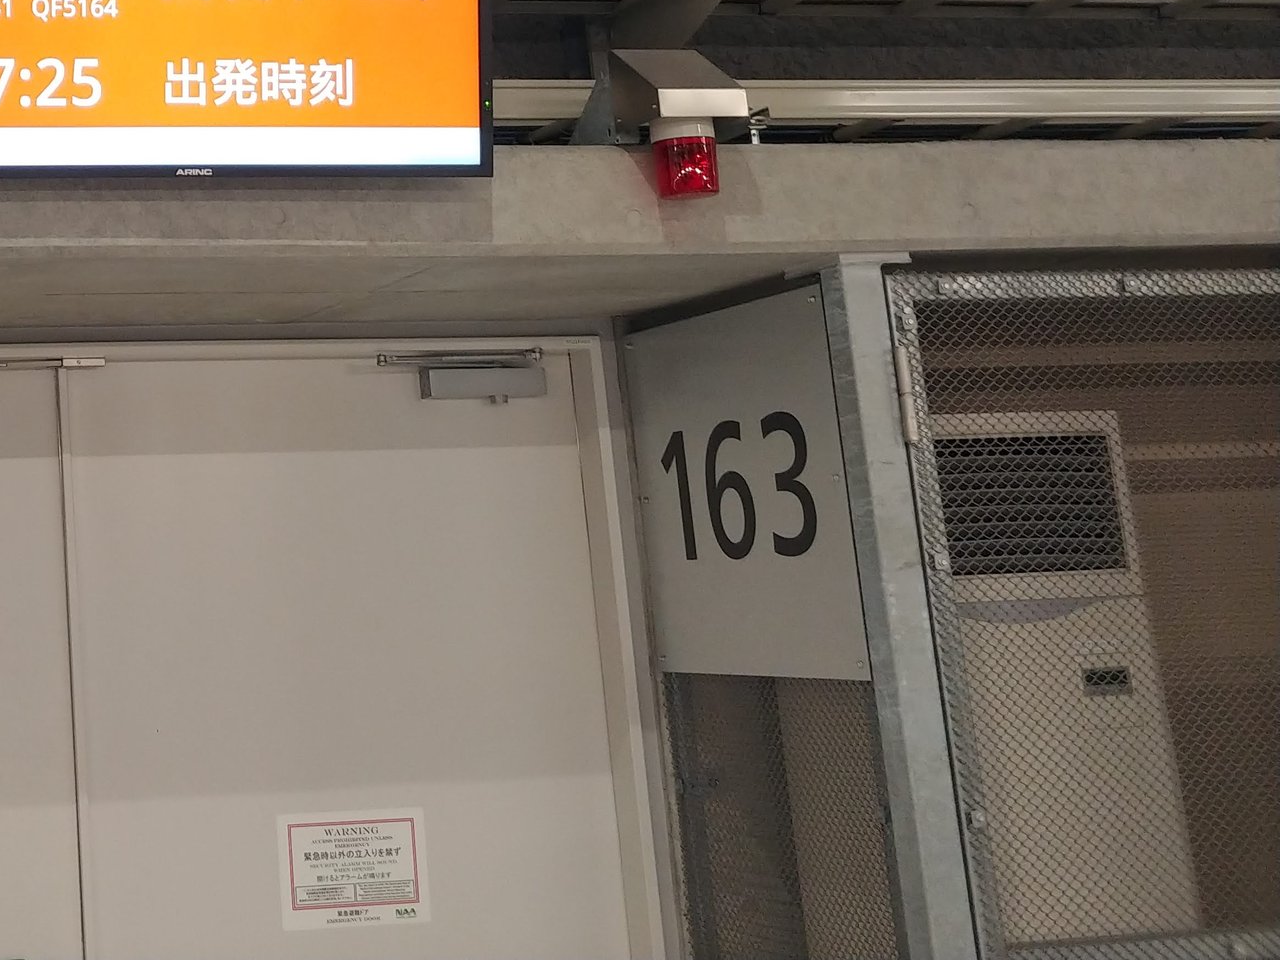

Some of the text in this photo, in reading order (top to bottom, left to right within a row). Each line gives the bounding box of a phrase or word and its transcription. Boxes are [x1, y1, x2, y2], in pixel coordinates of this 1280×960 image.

[164, 58, 356, 108] 出発時刻
[175, 168, 213, 177] ARINC
[661, 411, 818, 561] 163
[324, 826, 379, 836] WARNING
[304, 847, 401, 861] 緊急時以外の立入りを禁ず
[395, 908, 416, 916] NAA
